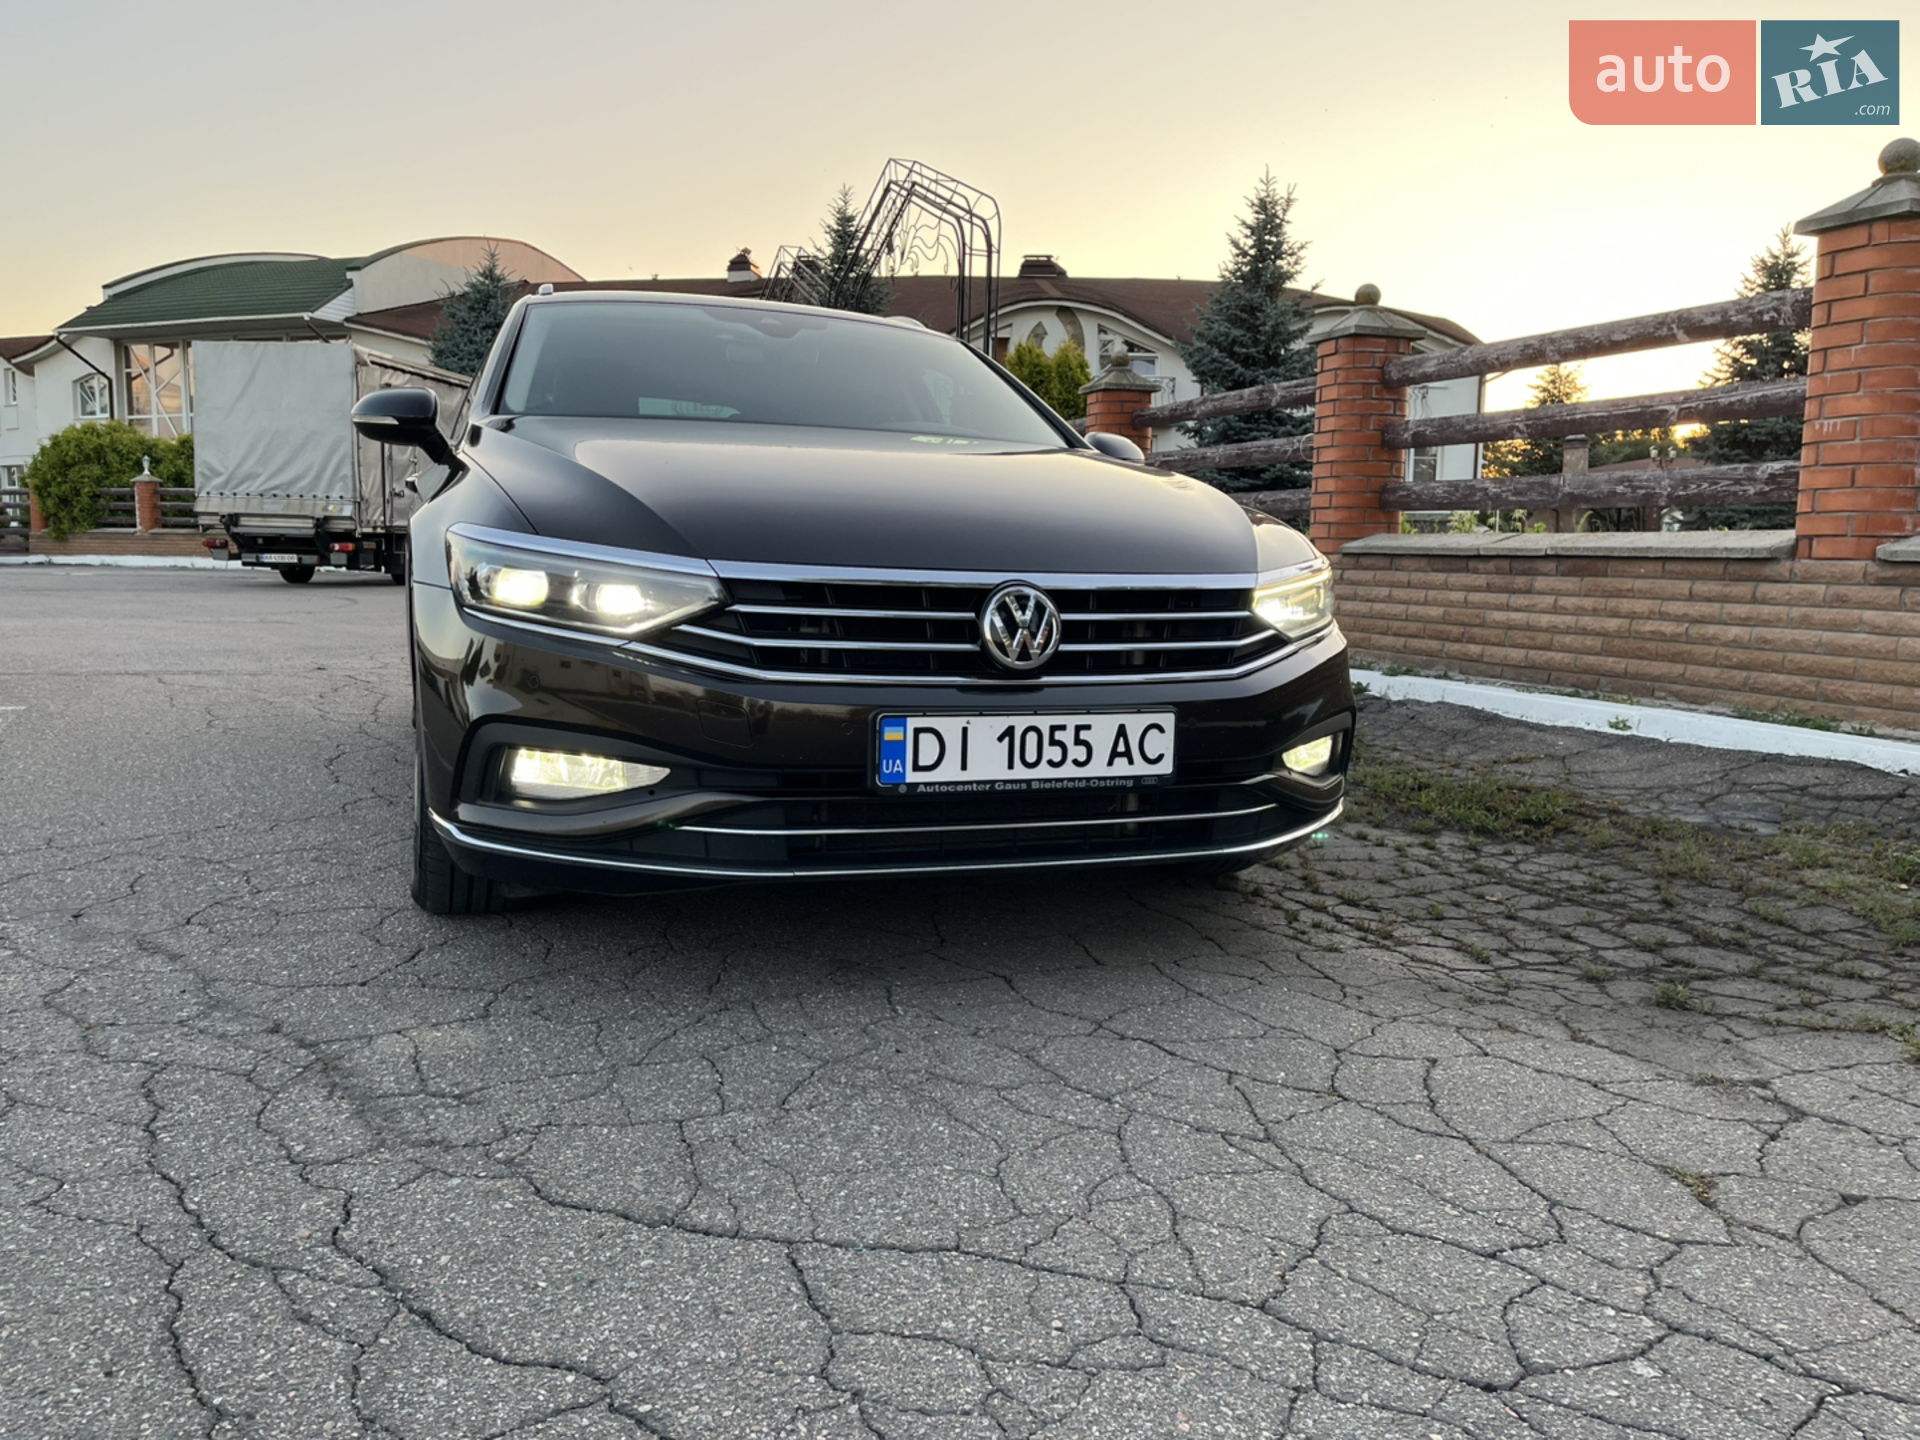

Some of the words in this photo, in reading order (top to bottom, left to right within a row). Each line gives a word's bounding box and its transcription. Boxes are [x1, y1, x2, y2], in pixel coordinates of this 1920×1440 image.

[912, 726, 969, 773] DI
[996, 723, 1094, 770] 1055
[1106, 723, 1166, 767] AC
[882, 759, 904, 774] UA
[916, 782, 992, 793] Autocenter
[994, 781, 1028, 791] Gaus
[1031, 778, 1134, 790] Bielefeld-Ostring
